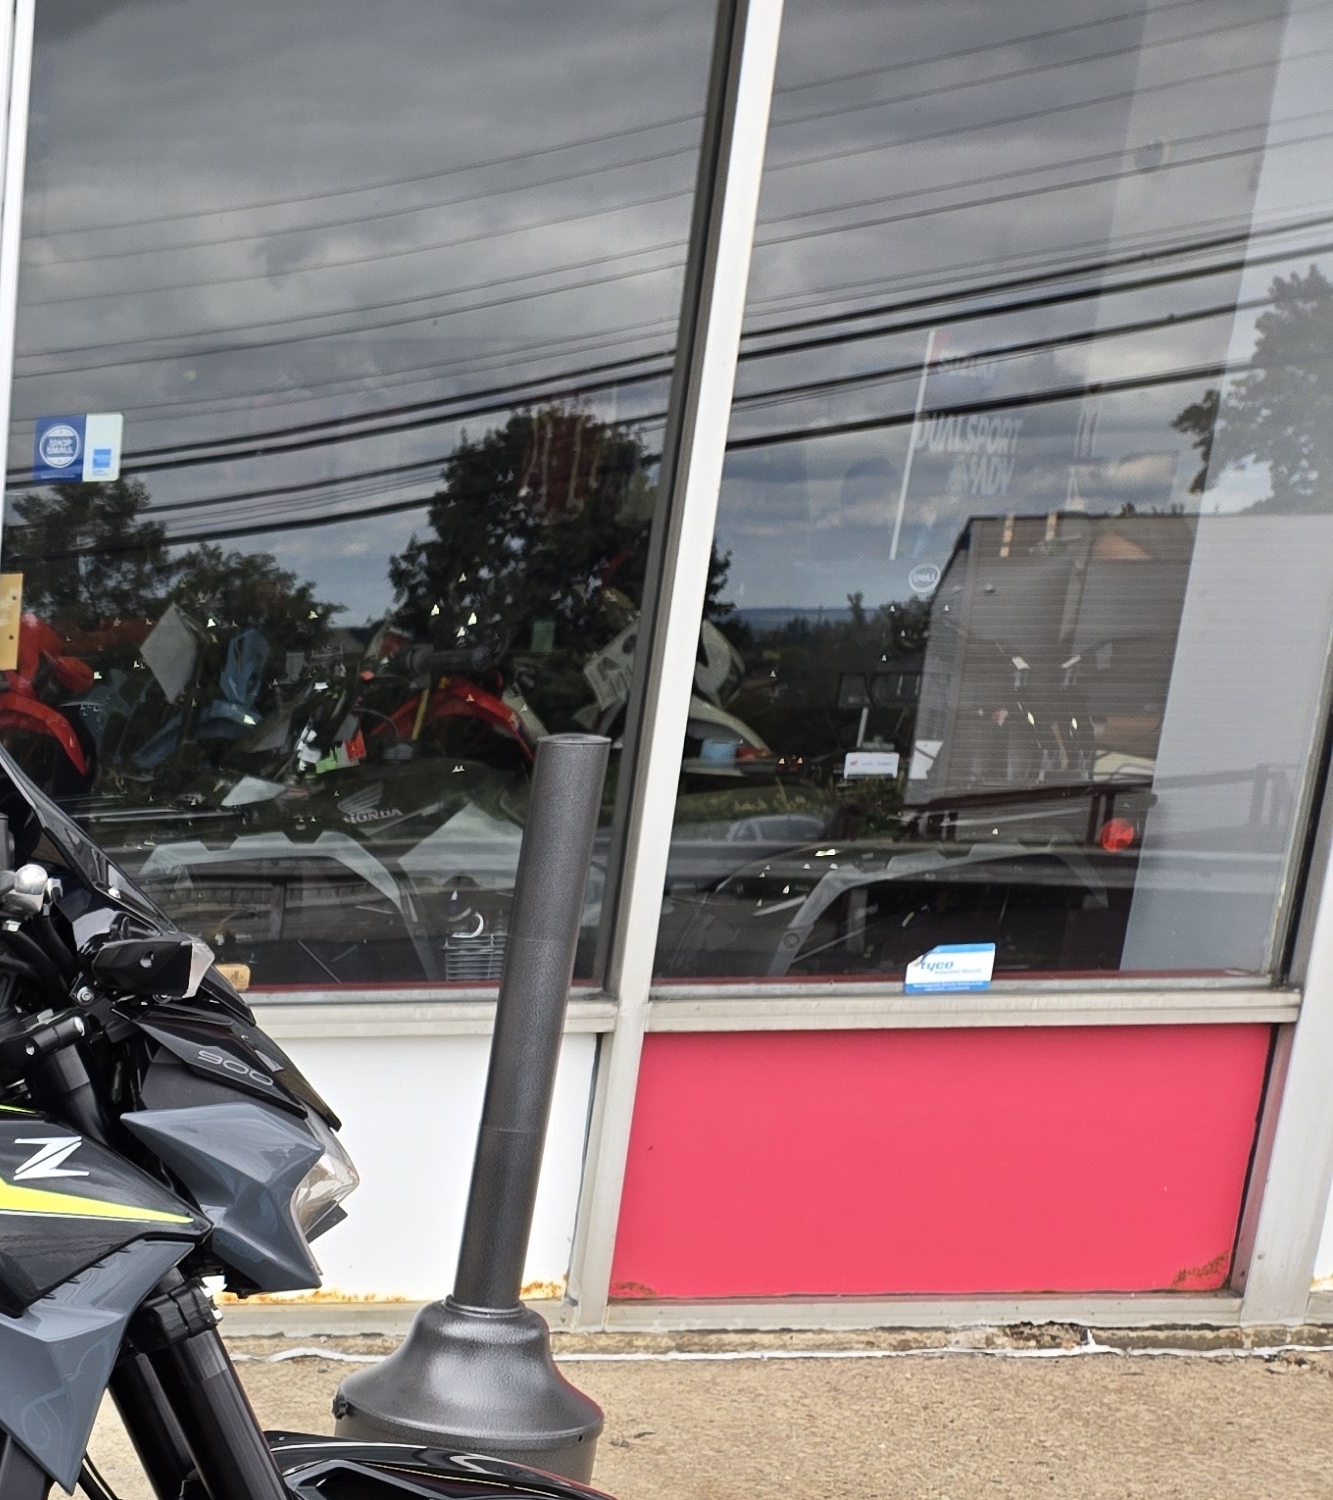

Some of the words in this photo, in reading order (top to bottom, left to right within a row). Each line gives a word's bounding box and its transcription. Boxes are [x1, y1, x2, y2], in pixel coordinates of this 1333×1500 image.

[920, 961, 954, 972] tyco
[197, 1049, 275, 1087] 900
[13, 1135, 90, 1181] Z
